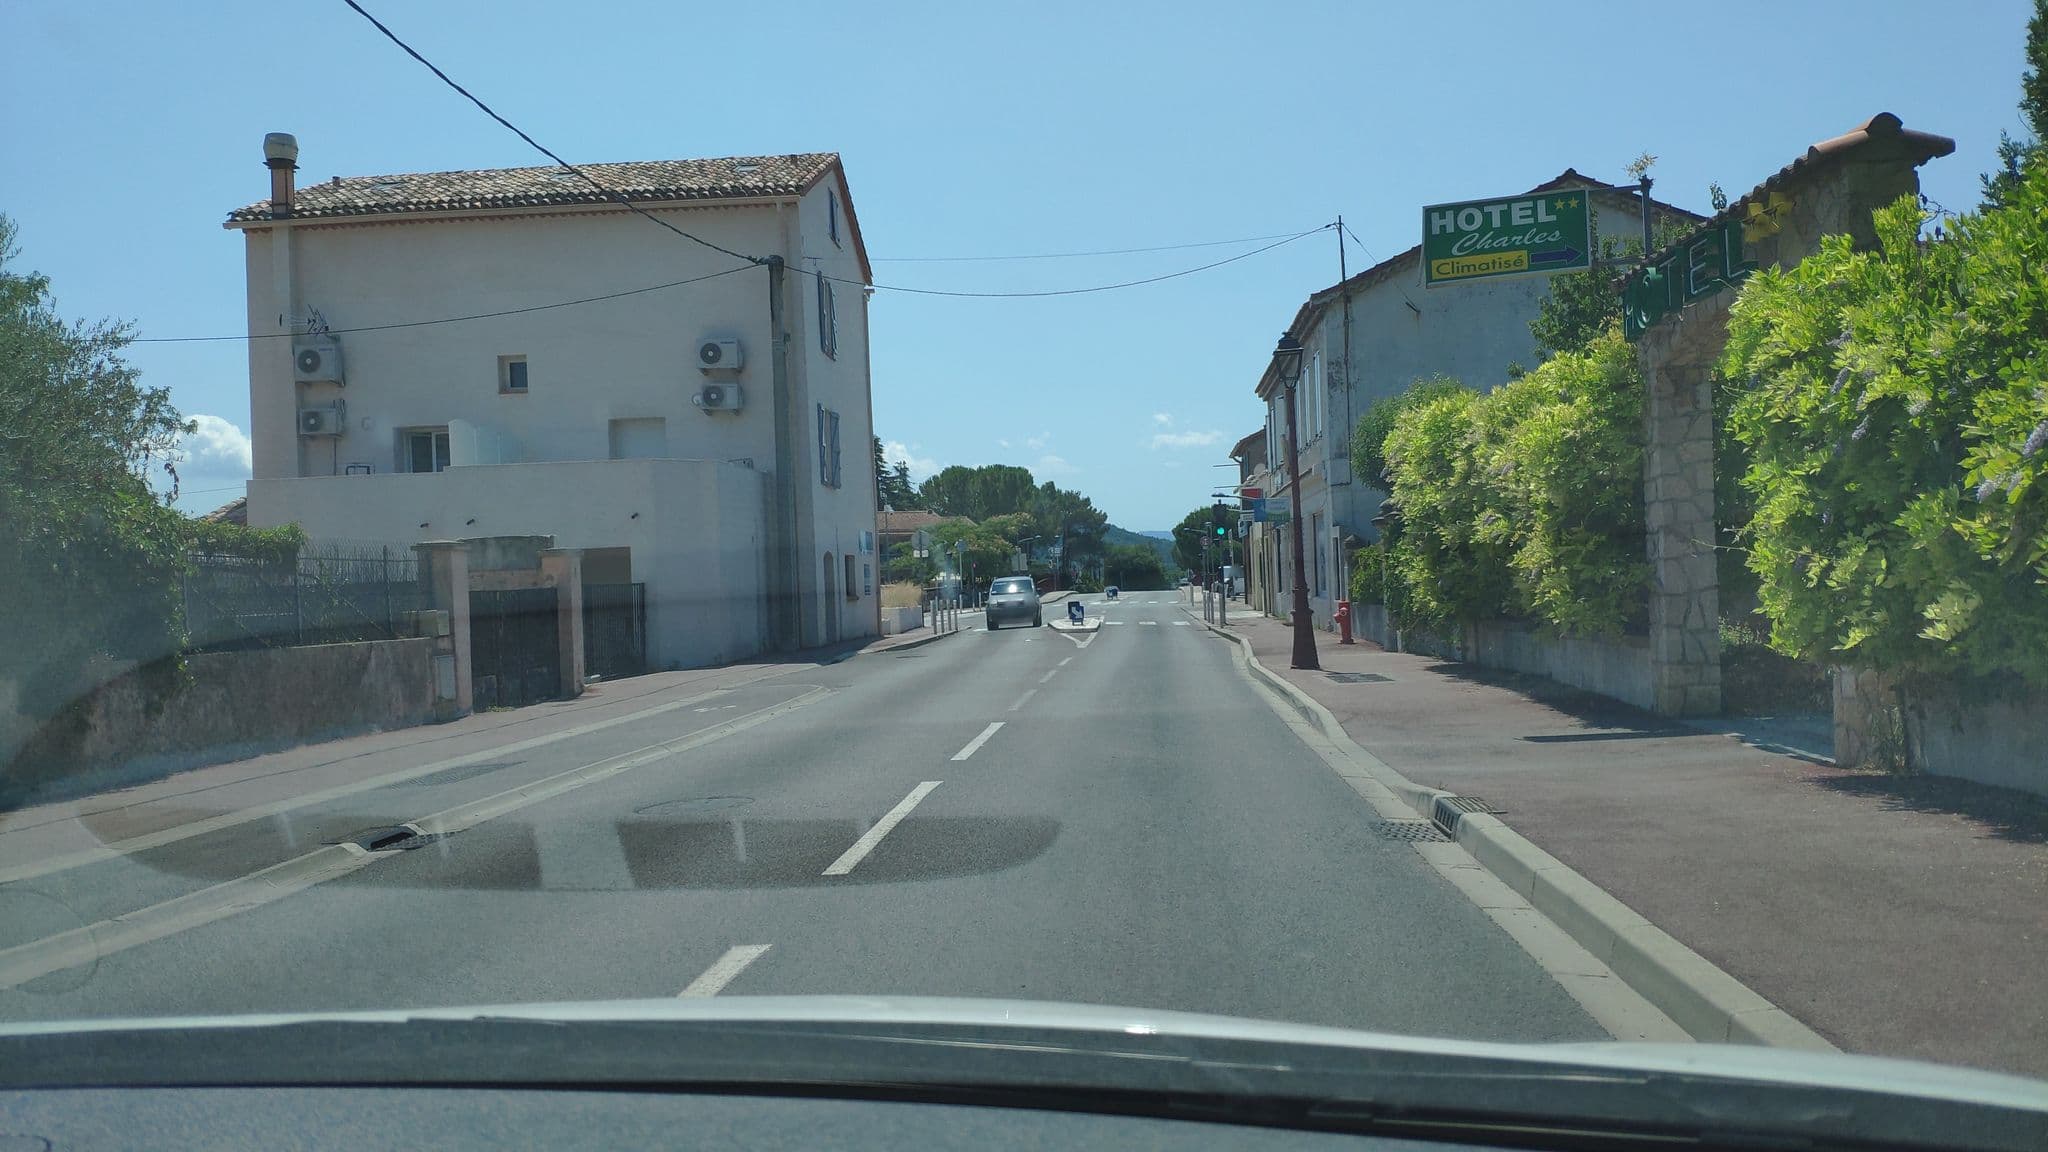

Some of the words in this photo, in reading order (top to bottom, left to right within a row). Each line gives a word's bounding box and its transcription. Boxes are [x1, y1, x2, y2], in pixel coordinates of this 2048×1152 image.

[1431, 199, 1557, 235] HOTEL
[1451, 227, 1562, 256] Charles
[1436, 255, 1525, 276] Climatisé
